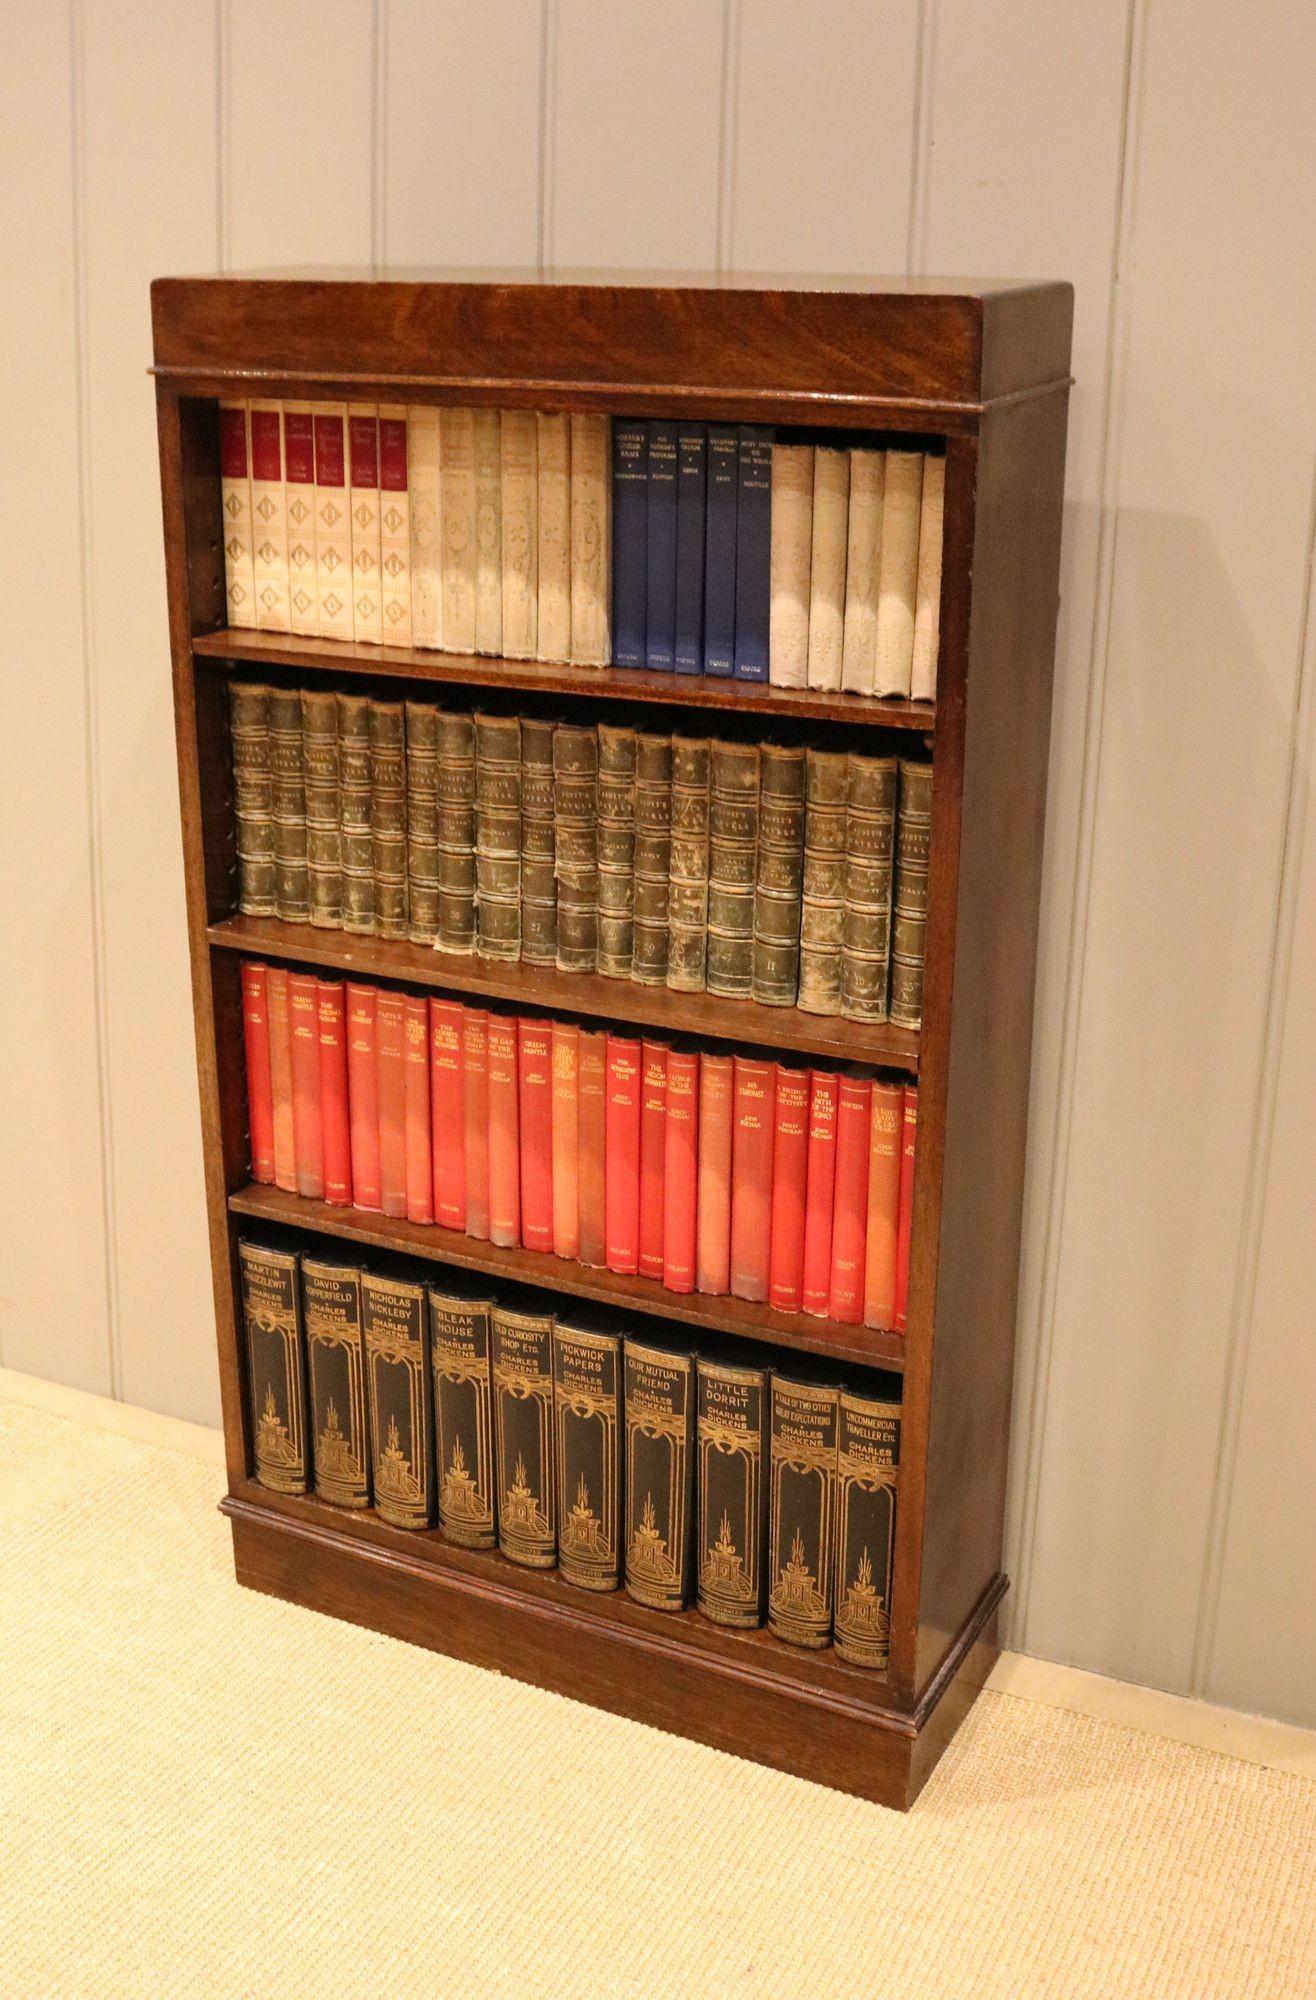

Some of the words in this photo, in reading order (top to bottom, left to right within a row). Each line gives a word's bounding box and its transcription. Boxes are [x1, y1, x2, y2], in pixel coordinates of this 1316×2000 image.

[247, 1261, 280, 1279] MARTIN
[313, 1277, 340, 1291] DAVID
[249, 1287, 282, 1301] CHARLES
[305, 1286, 352, 1302] COPPERFIELD
[369, 1291, 411, 1309] NICHOLAS
[310, 1302, 346, 1315] CHARLES
[369, 1302, 412, 1320] NICKLEBY
[310, 1310, 347, 1323] DICKENS
[437, 1311, 474, 1326] BLEAK
[372, 1317, 409, 1332] CHARLES
[437, 1323, 474, 1338] HOUSE
[373, 1325, 410, 1340] DICKENS
[494, 1323, 507, 1336] OLD
[508, 1329, 545, 1343] CURIOSITY
[436, 1337, 475, 1351] CHARLES
[437, 1345, 476, 1358] DICKENS
[500, 1338, 521, 1351] SHOP
[500, 1352, 539, 1367] CHARLES
[560, 1343, 605, 1362] PICKWICK
[500, 1360, 539, 1375] DICKENS
[563, 1355, 602, 1372] PAPERS
[628, 1358, 644, 1373] OUR
[645, 1364, 680, 1381] MUTUAL
[563, 1370, 603, 1386] CHARLES
[563, 1378, 603, 1393] DICKENS
[636, 1374, 670, 1391] FRIEND
[707, 1379, 749, 1396] LITTLE
[633, 1389, 673, 1406] CHARLES
[633, 1396, 673, 1414] DICKENS
[706, 1390, 749, 1408] DORRIT
[798, 1399, 812, 1411] TWO
[812, 1401, 832, 1413] CITIES
[707, 1406, 747, 1422] CHARLES
[707, 1413, 747, 1430] DICKENS
[775, 1406, 790, 1419] GREAT
[790, 1410, 831, 1426] EXPECTATIONS
[846, 1412, 897, 1431] UNCOMMERCIAL
[781, 1424, 824, 1439] CHARLES
[846, 1423, 881, 1441] TRAVELLER
[780, 1432, 824, 1447] DICKENS
[849, 1441, 892, 1456] CHARLES
[848, 1450, 892, 1465] DICKENS
